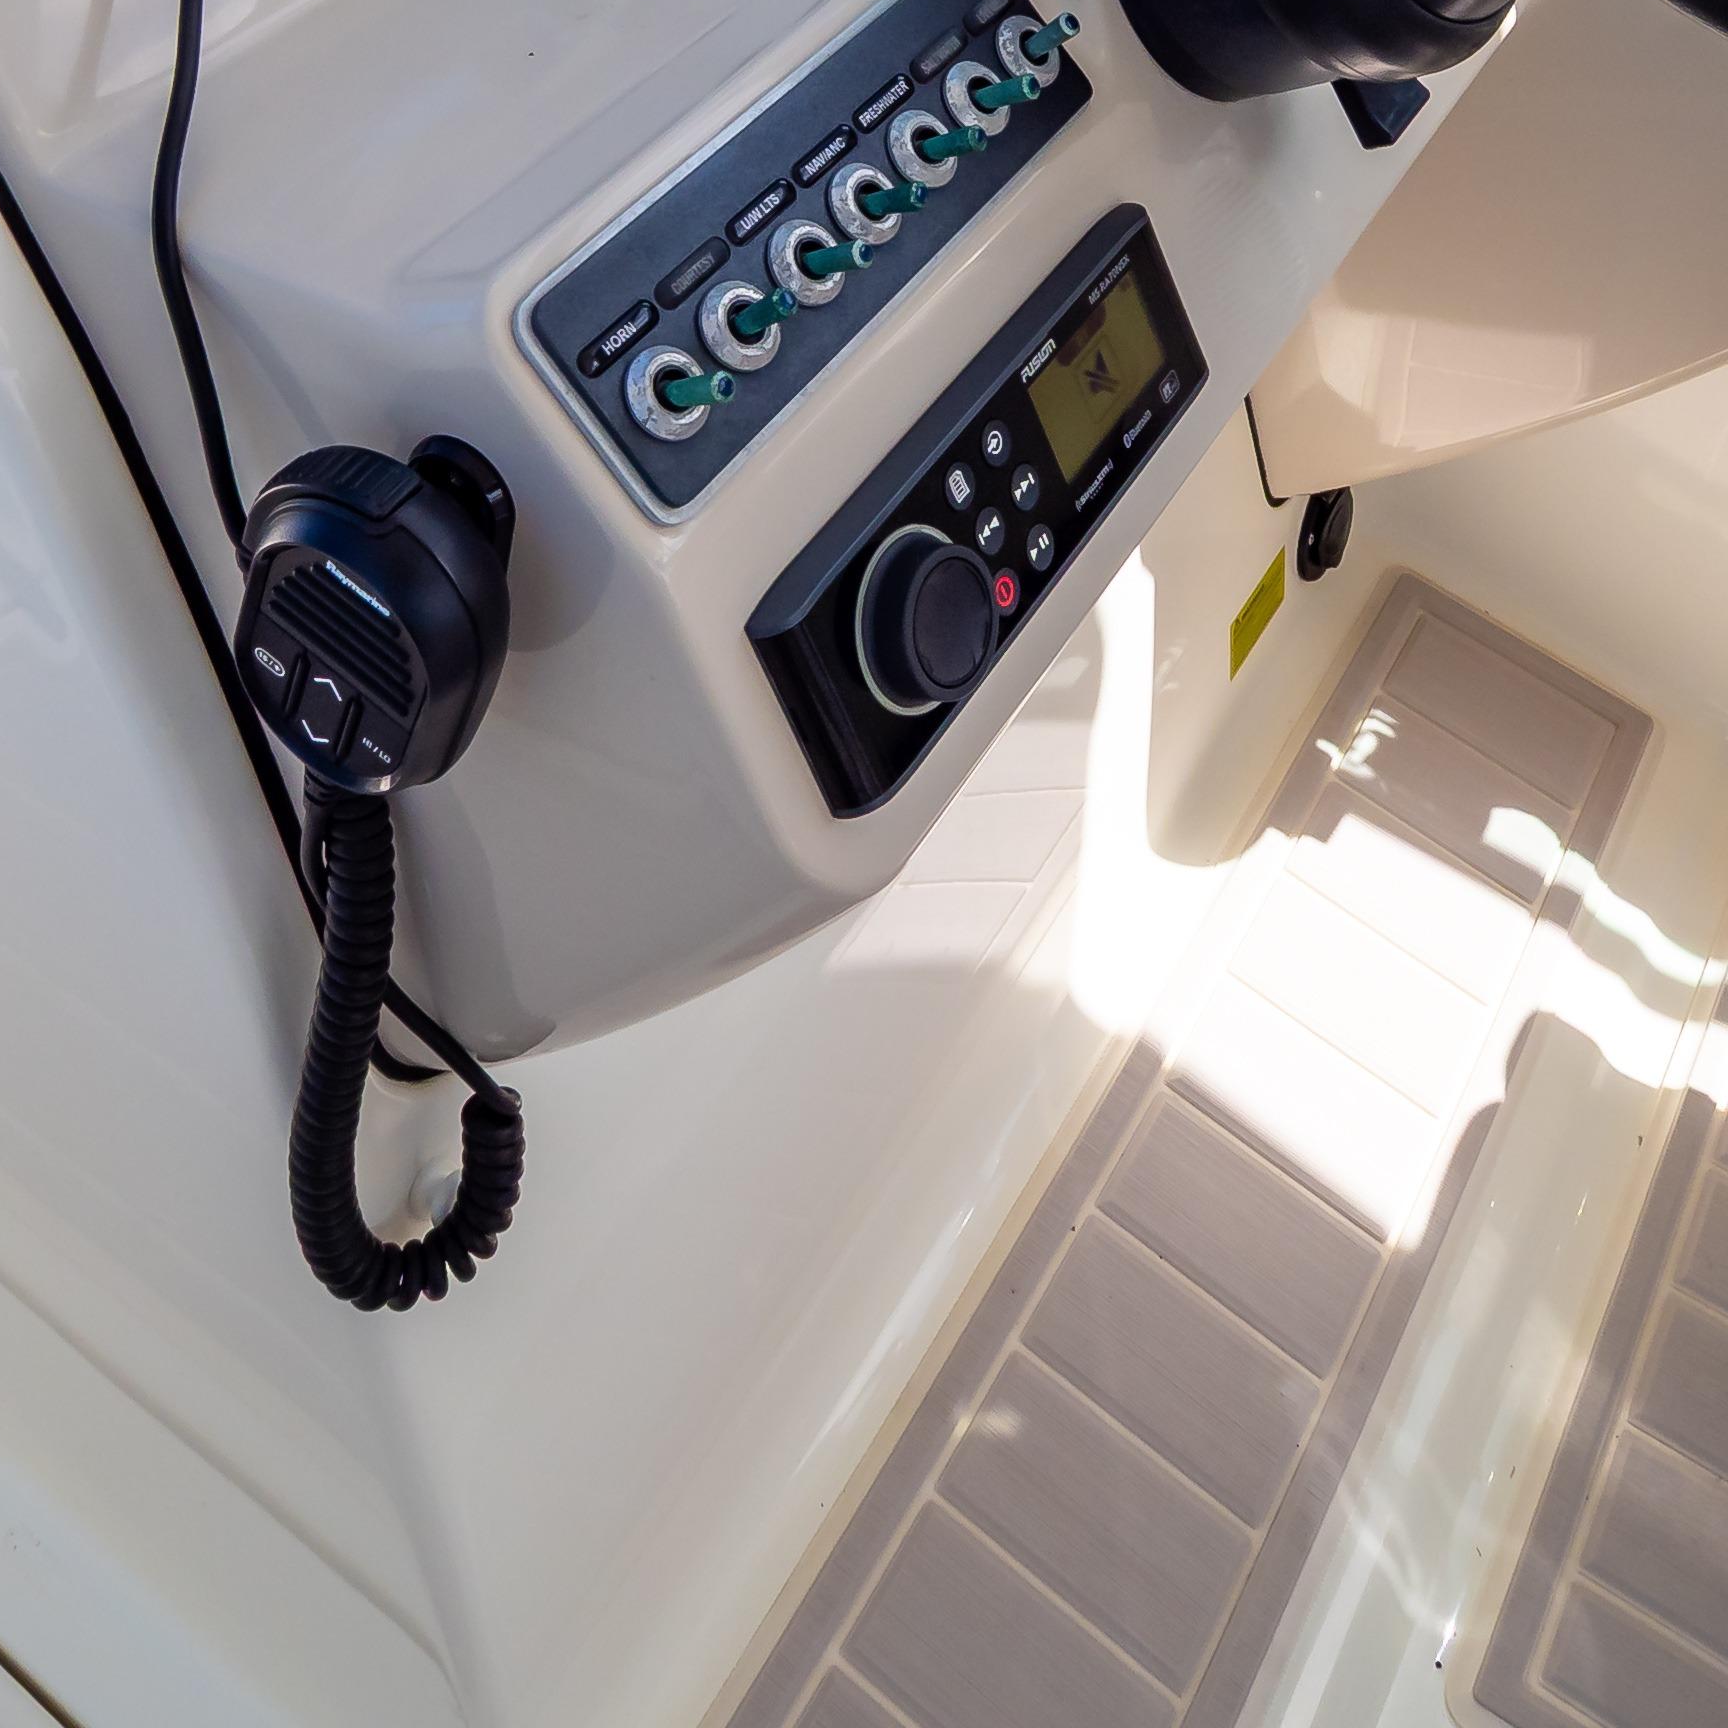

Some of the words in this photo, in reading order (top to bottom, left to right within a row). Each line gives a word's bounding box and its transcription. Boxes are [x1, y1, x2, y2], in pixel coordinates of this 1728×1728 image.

[859, 80, 910, 127] FRESHWATER
[804, 136, 846, 176] NAV/ANC
[671, 252, 714, 295] COURTESY
[601, 321, 637, 356] HORN
[1020, 338, 1057, 384] FUSION
[325, 560, 391, 617] Raymarine
